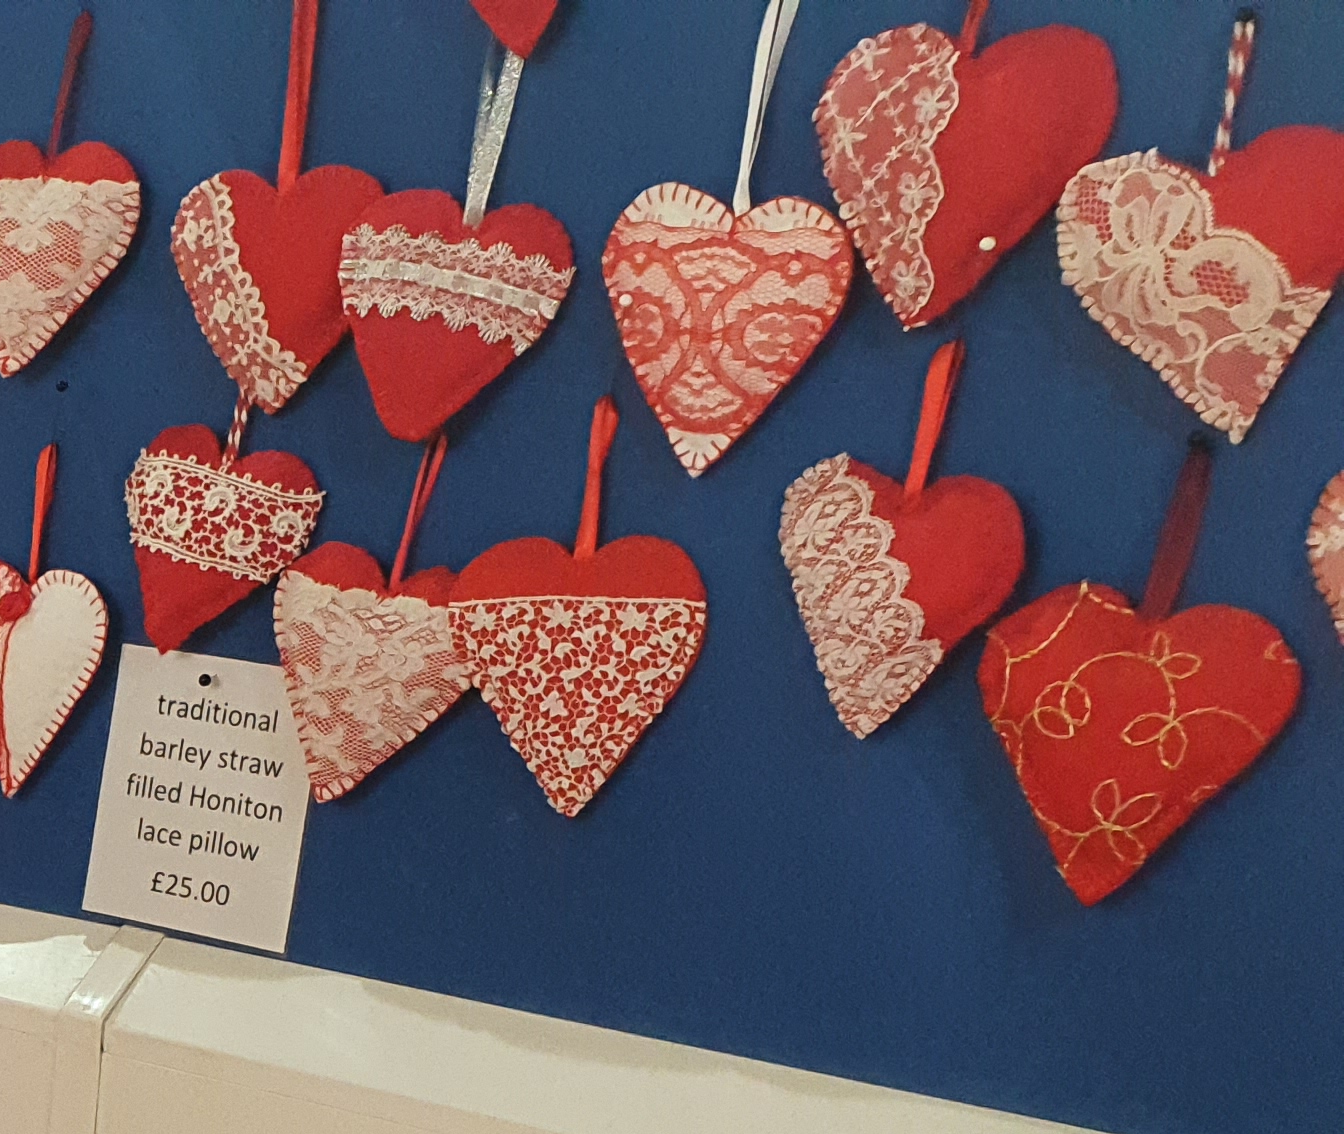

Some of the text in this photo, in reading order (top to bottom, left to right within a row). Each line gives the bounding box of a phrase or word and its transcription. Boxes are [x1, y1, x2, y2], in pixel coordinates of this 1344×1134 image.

[157, 694, 280, 734] traditional
[139, 731, 285, 779] barley straw
[126, 772, 284, 824] filled Honiton
[136, 816, 261, 862] lace pillow
[150, 871, 231, 906] £25.00
